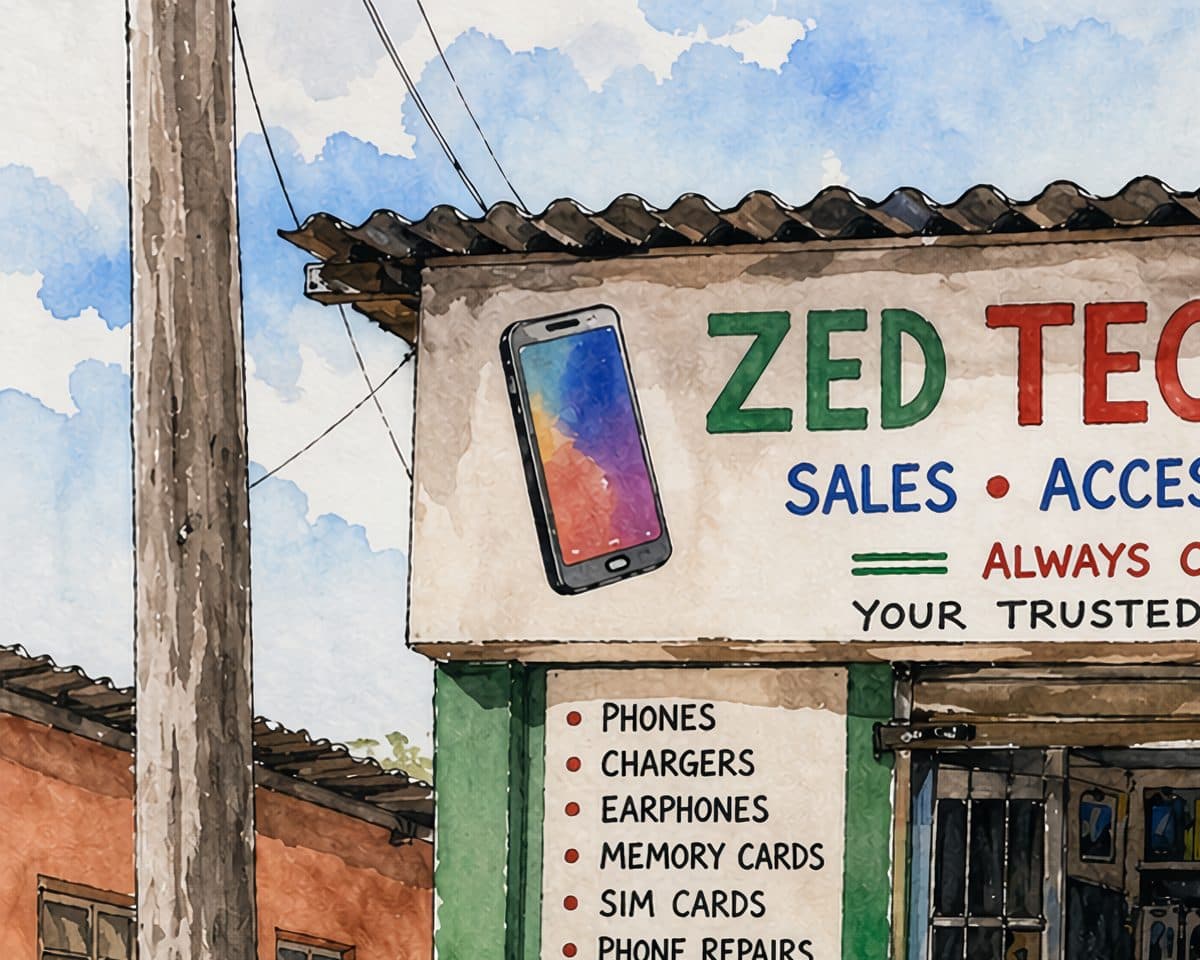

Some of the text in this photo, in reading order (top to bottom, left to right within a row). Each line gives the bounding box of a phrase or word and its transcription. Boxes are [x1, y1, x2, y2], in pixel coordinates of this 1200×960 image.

[706, 308, 947, 434] ZED
[785, 461, 958, 516] SALES
[982, 542, 1151, 580] ALWAYS
[852, 599, 967, 631] YOUR
[602, 702, 716, 732] PHONES
[601, 749, 755, 777] CHARGERS
[601, 795, 769, 823] EARPHONES
[600, 842, 825, 871] MEMORY CARDS
[599, 889, 766, 918] SIM CARDS
